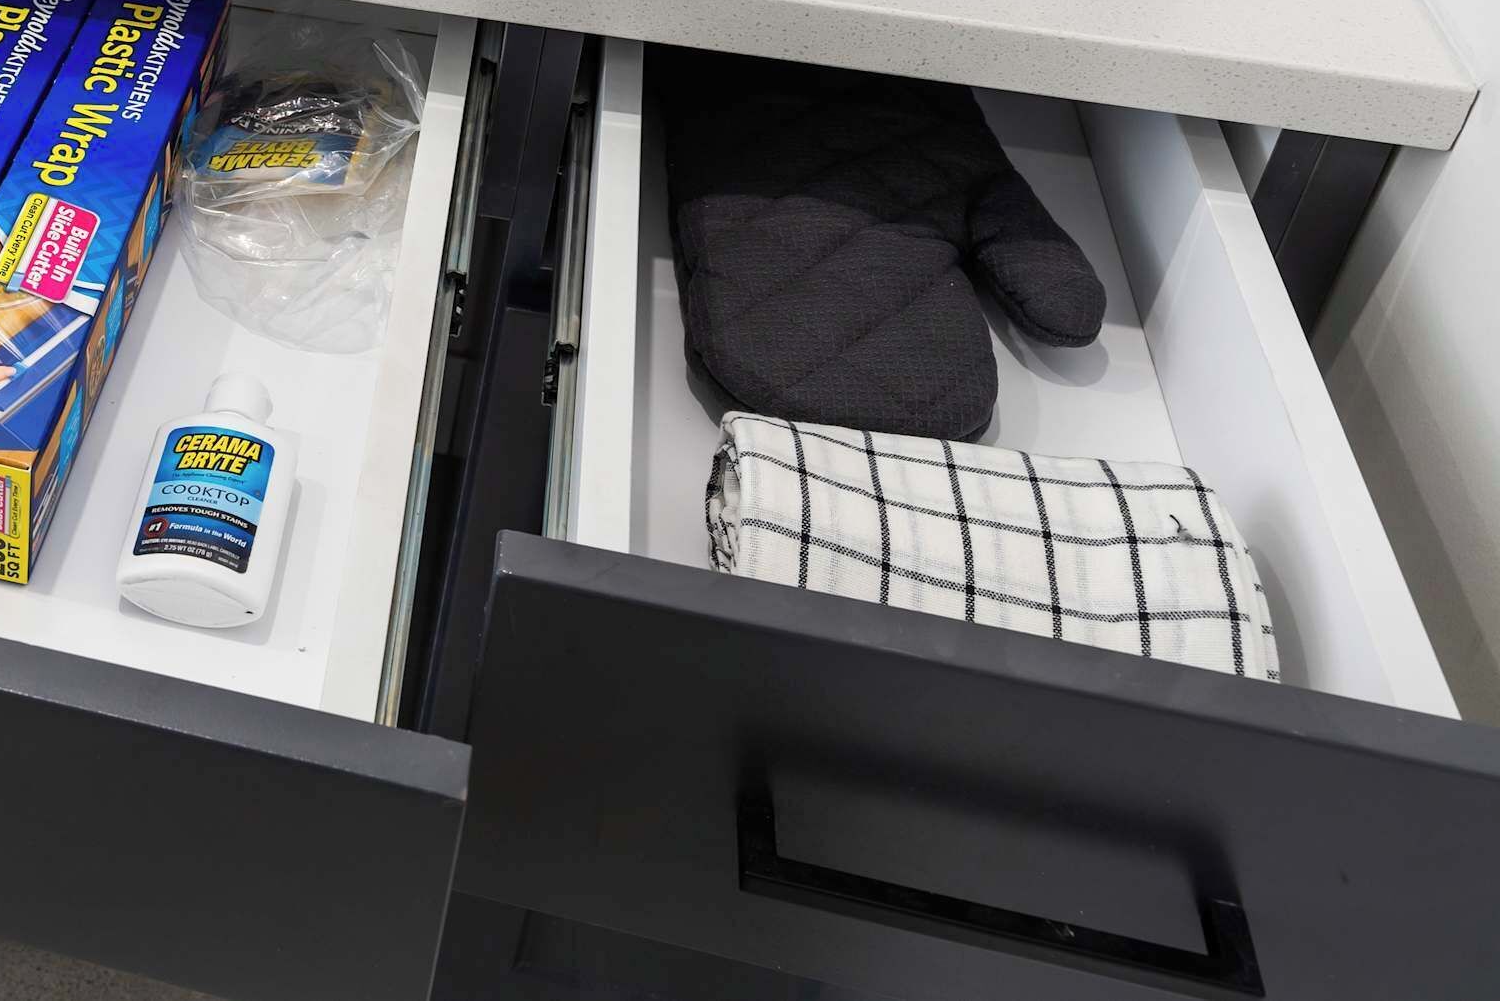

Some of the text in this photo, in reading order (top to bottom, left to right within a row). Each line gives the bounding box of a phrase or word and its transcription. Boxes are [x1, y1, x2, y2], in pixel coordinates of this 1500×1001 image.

[37, 2, 164, 187] Plastic Wrap
[121, 50, 169, 121] KITCHENS
[209, 153, 321, 172] CERAMA
[0, 198, 43, 277] Clean Cut Every Time
[26, 205, 76, 290] Slide Cutter
[50, 226, 90, 282] Built-In
[174, 433, 262, 461] CERAMA
[177, 450, 247, 475] BRYTE
[161, 484, 250, 507] COOKTOP
[187, 496, 219, 505] CLEANER
[191, 507, 219, 518] TOUGH
[221, 513, 249, 529] STAINS
[169, 522, 203, 532] Formula
[211, 529, 223, 537] the
[223, 532, 248, 548] World
[7, 542, 21, 579] SQ FT
